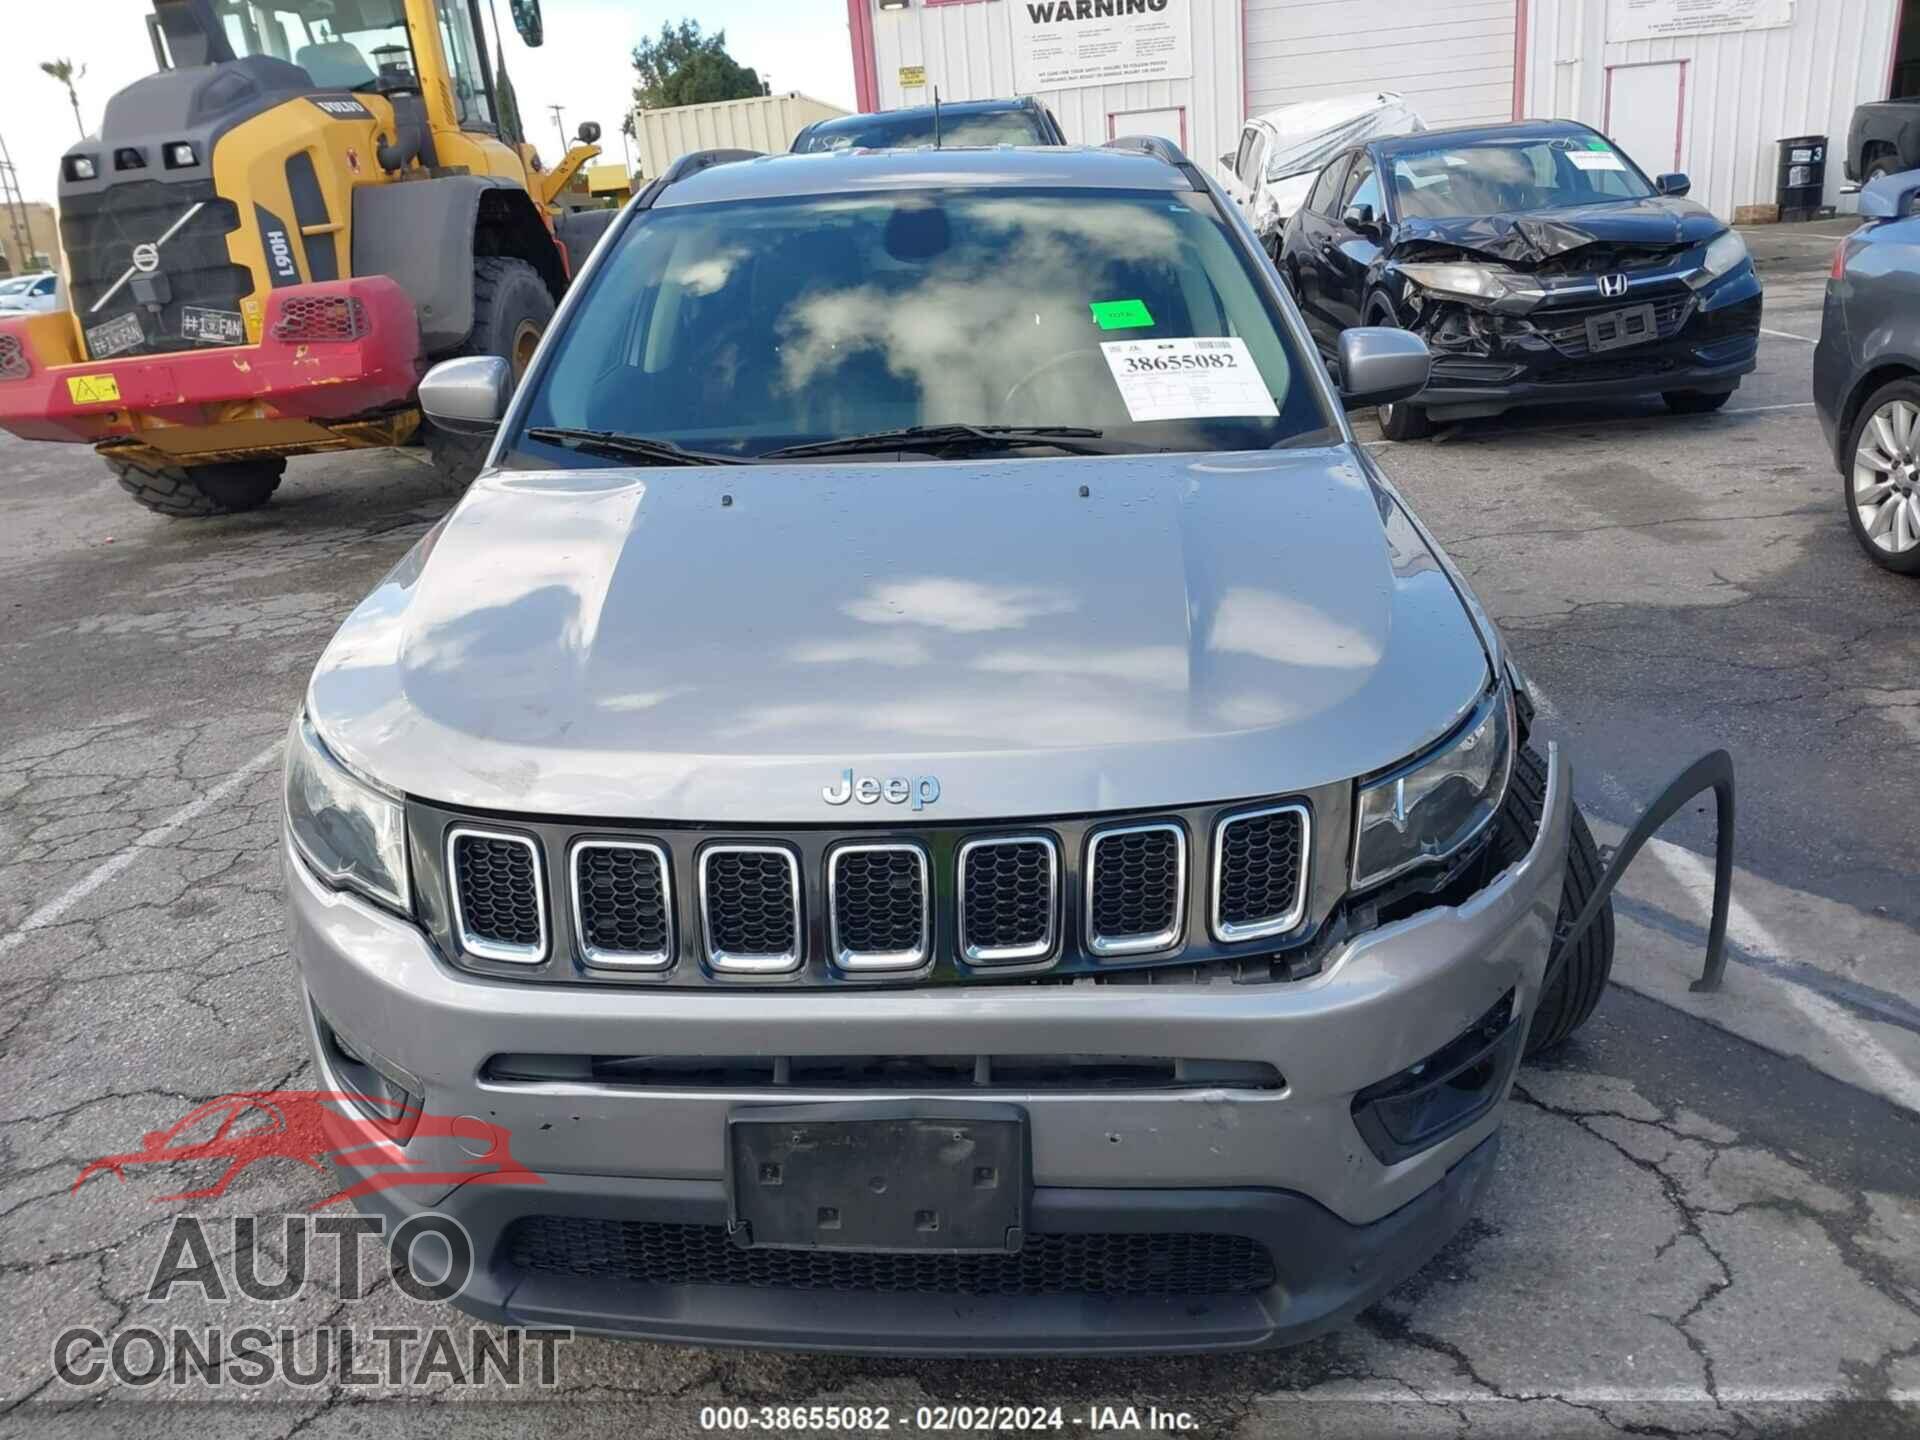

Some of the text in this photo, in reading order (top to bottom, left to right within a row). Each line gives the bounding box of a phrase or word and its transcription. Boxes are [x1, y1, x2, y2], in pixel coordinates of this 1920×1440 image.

[1027, 0, 1168, 24] WARNING
[1813, 146, 1822, 161] 3
[267, 230, 295, 276] L90H
[1124, 353, 1238, 373] 38655082
[822, 768, 941, 811] Jeep
